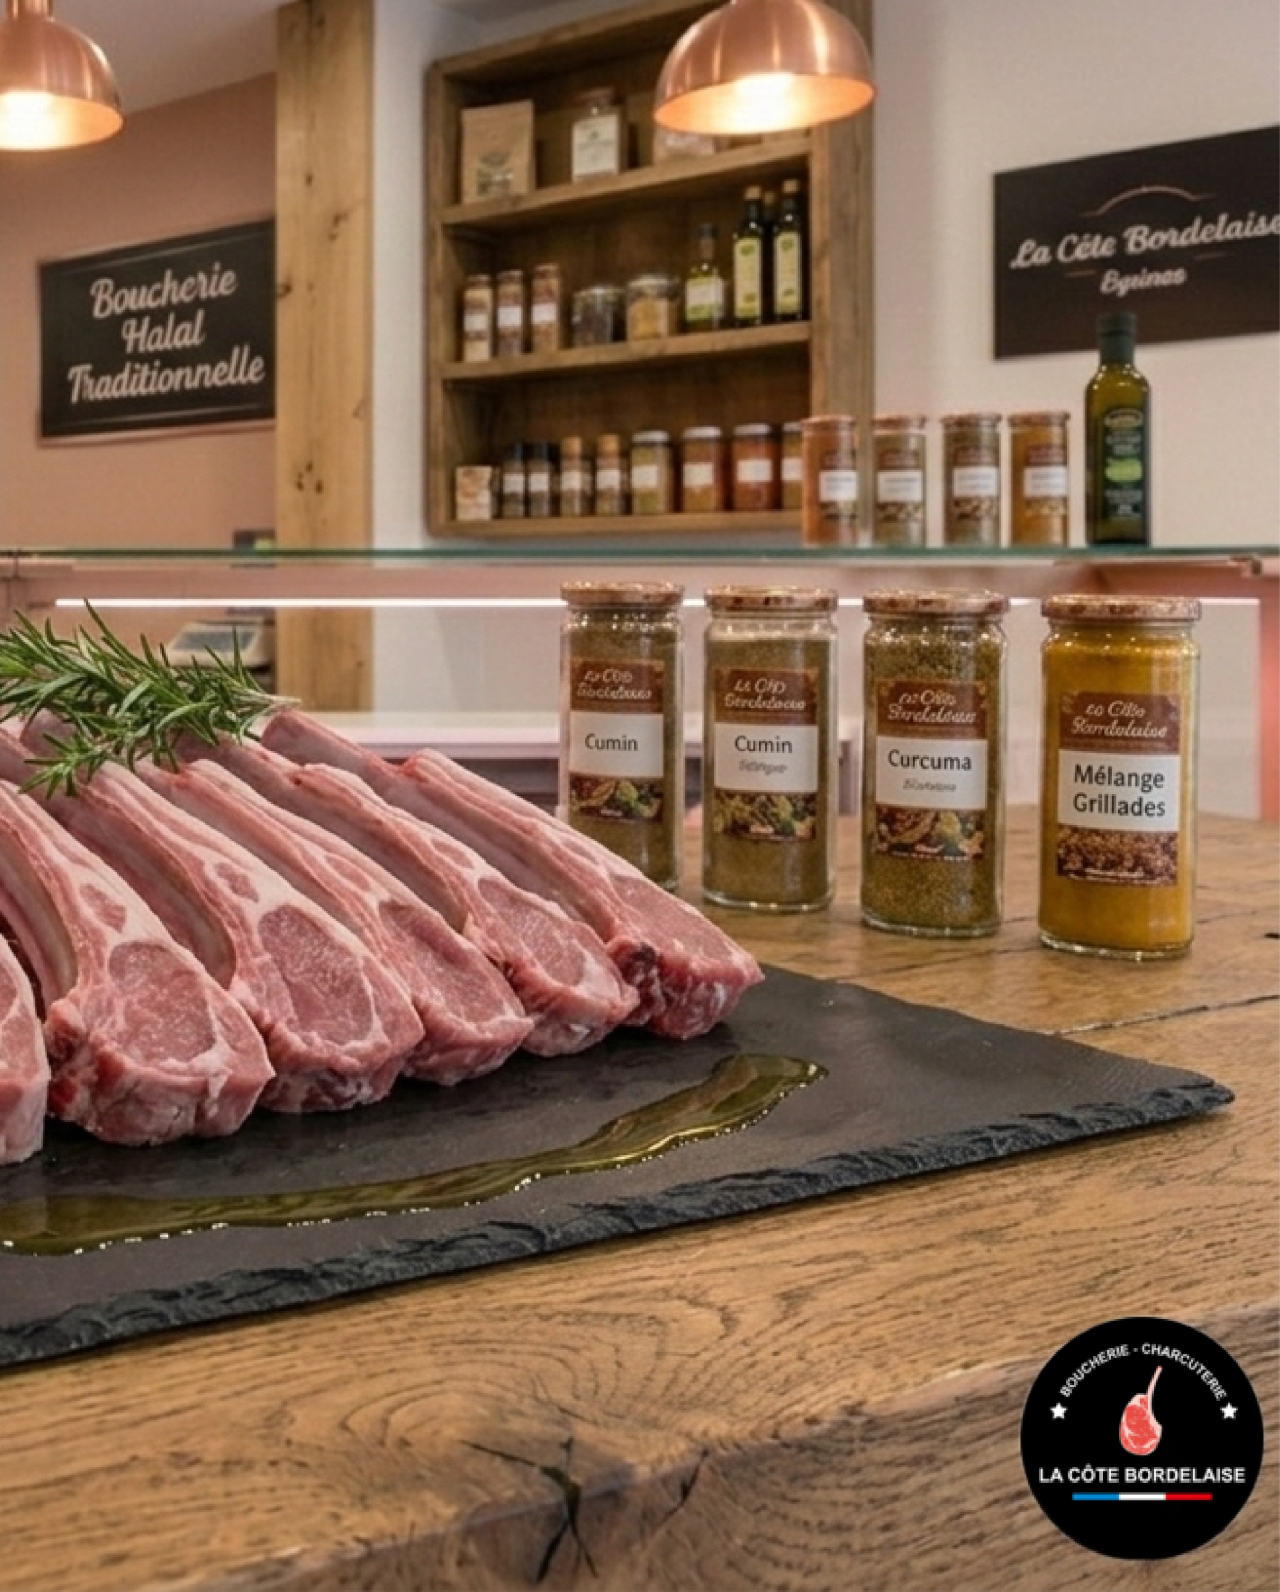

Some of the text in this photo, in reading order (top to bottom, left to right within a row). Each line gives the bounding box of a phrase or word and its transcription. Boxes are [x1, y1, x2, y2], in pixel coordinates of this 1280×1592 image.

[1009, 239, 1052, 269] La
[90, 261, 238, 319] Boucherie
[121, 307, 206, 354] Halal
[67, 344, 266, 405] Traditionnelle
[584, 733, 639, 752] Cumin
[734, 735, 793, 754] Cumin
[887, 749, 973, 772] Curcuma
[1073, 763, 1165, 794] Mélange
[1072, 792, 1166, 818] Grillades
